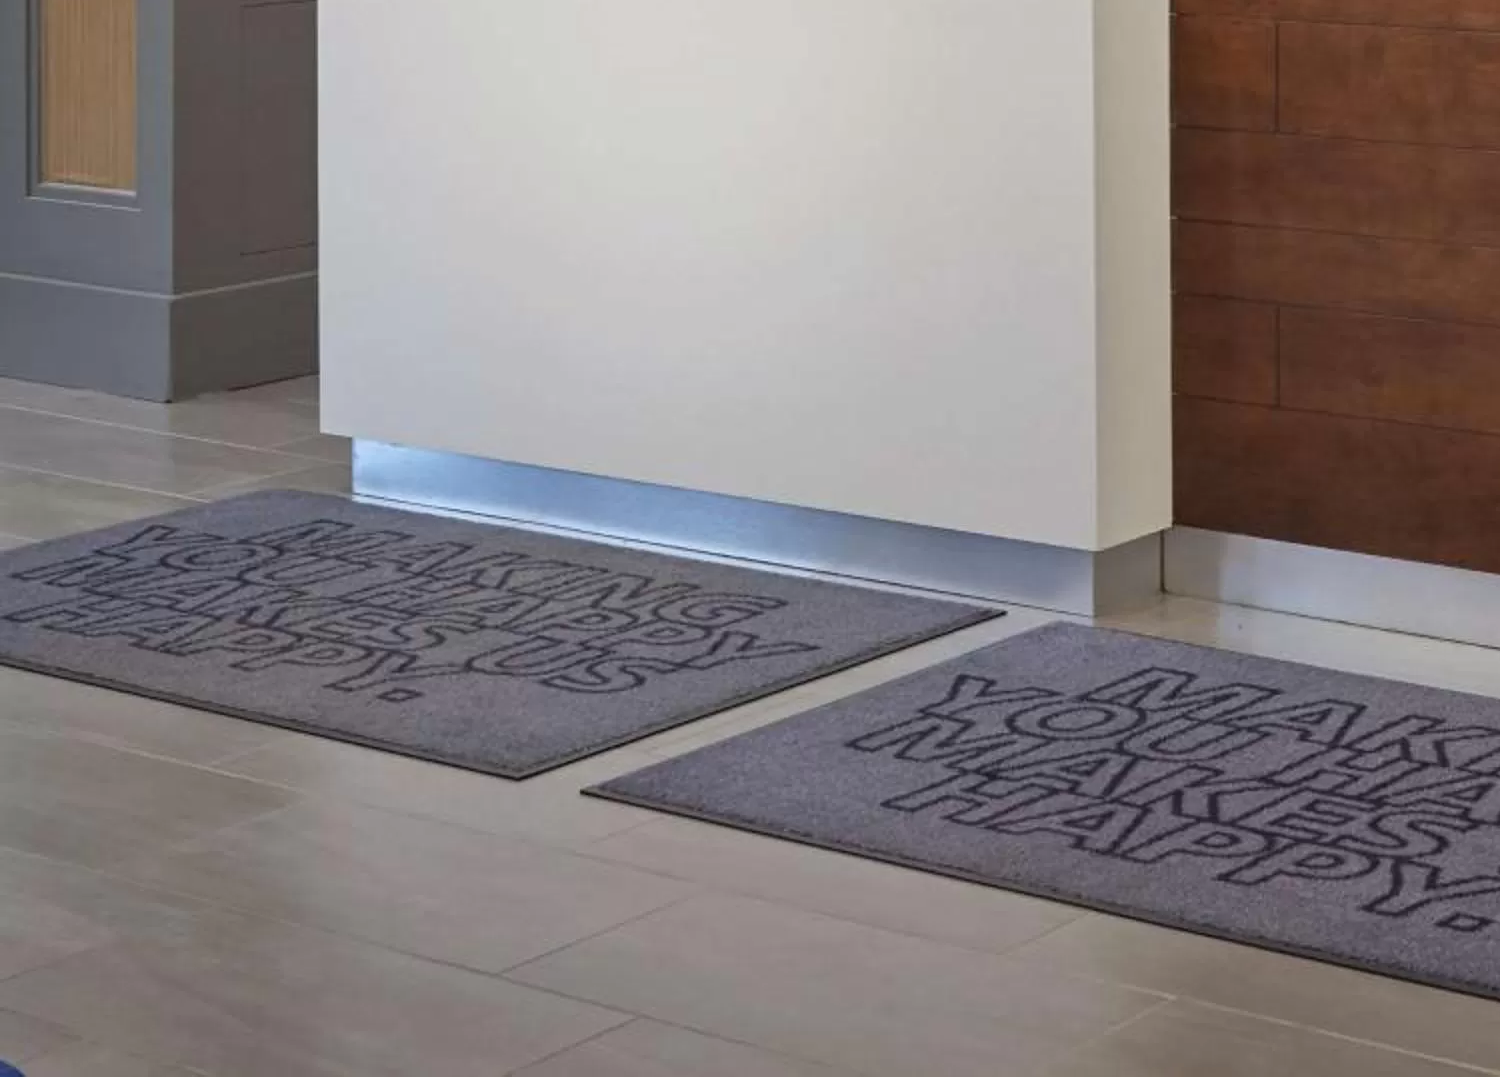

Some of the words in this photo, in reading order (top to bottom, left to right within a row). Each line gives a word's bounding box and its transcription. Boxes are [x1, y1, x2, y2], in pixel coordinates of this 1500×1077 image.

[11, 550, 484, 653] MAKES
[465, 635, 678, 694] US
[94, 524, 378, 586] YOU
[340, 568, 821, 670] HAPPY
[236, 519, 789, 626] MAKING
[2, 594, 467, 703] HAPPY.
[918, 674, 1274, 763] YOU
[844, 713, 1482, 859] MAKES
